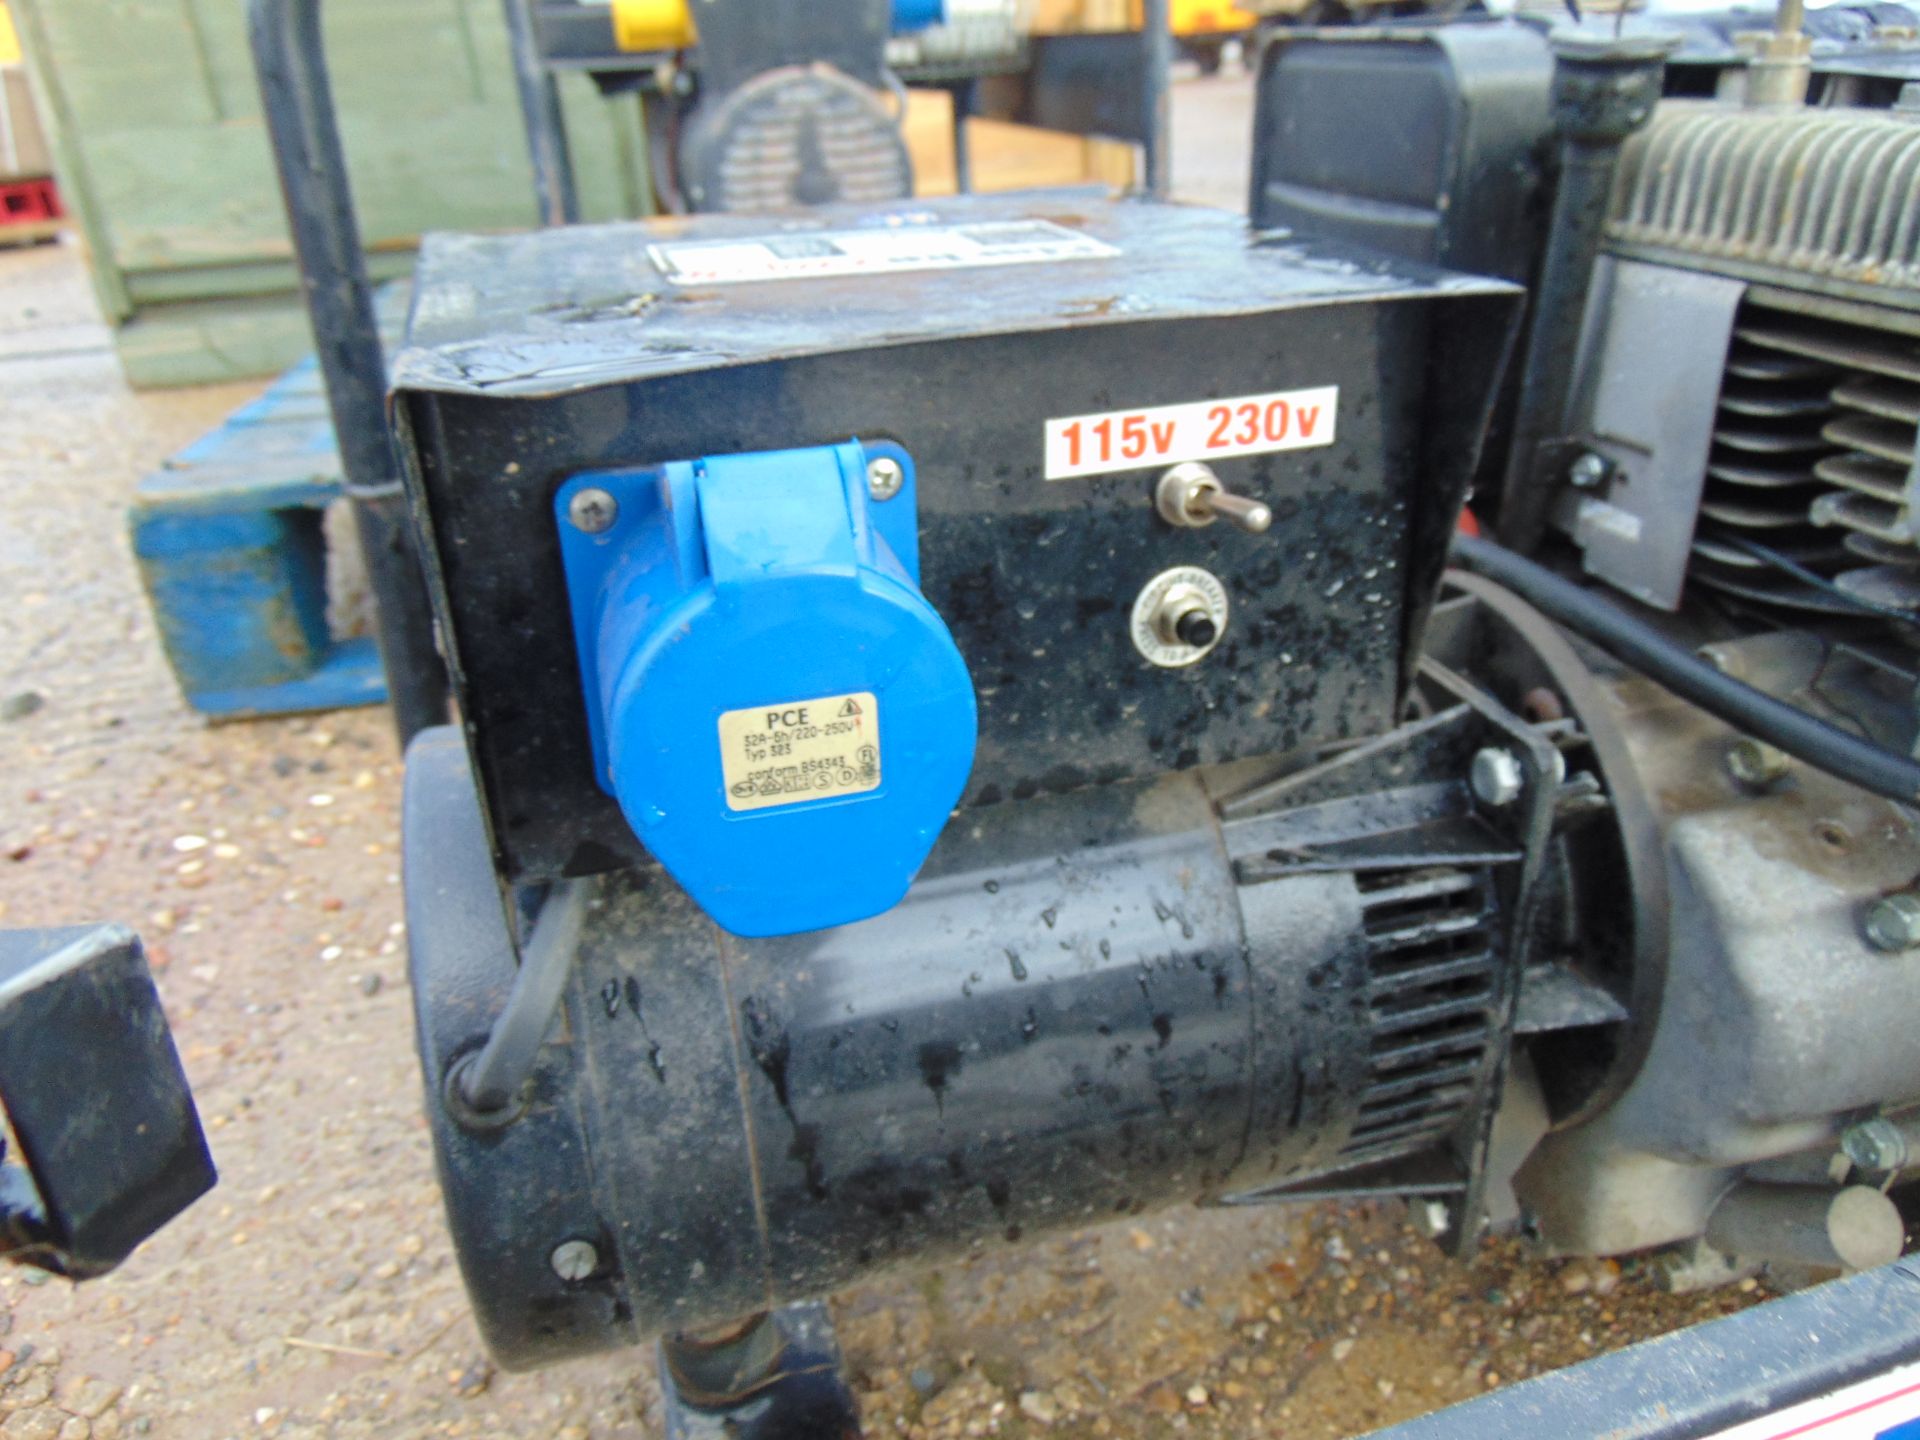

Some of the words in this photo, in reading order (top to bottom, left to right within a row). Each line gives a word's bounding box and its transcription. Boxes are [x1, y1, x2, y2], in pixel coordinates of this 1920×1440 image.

[1061, 415, 1176, 466] 115v
[1205, 400, 1320, 449] 230v
[767, 708, 809, 729] PCE
[745, 748, 766, 762] Typ
[770, 743, 792, 757] 323
[801, 755, 846, 773] BS4343
